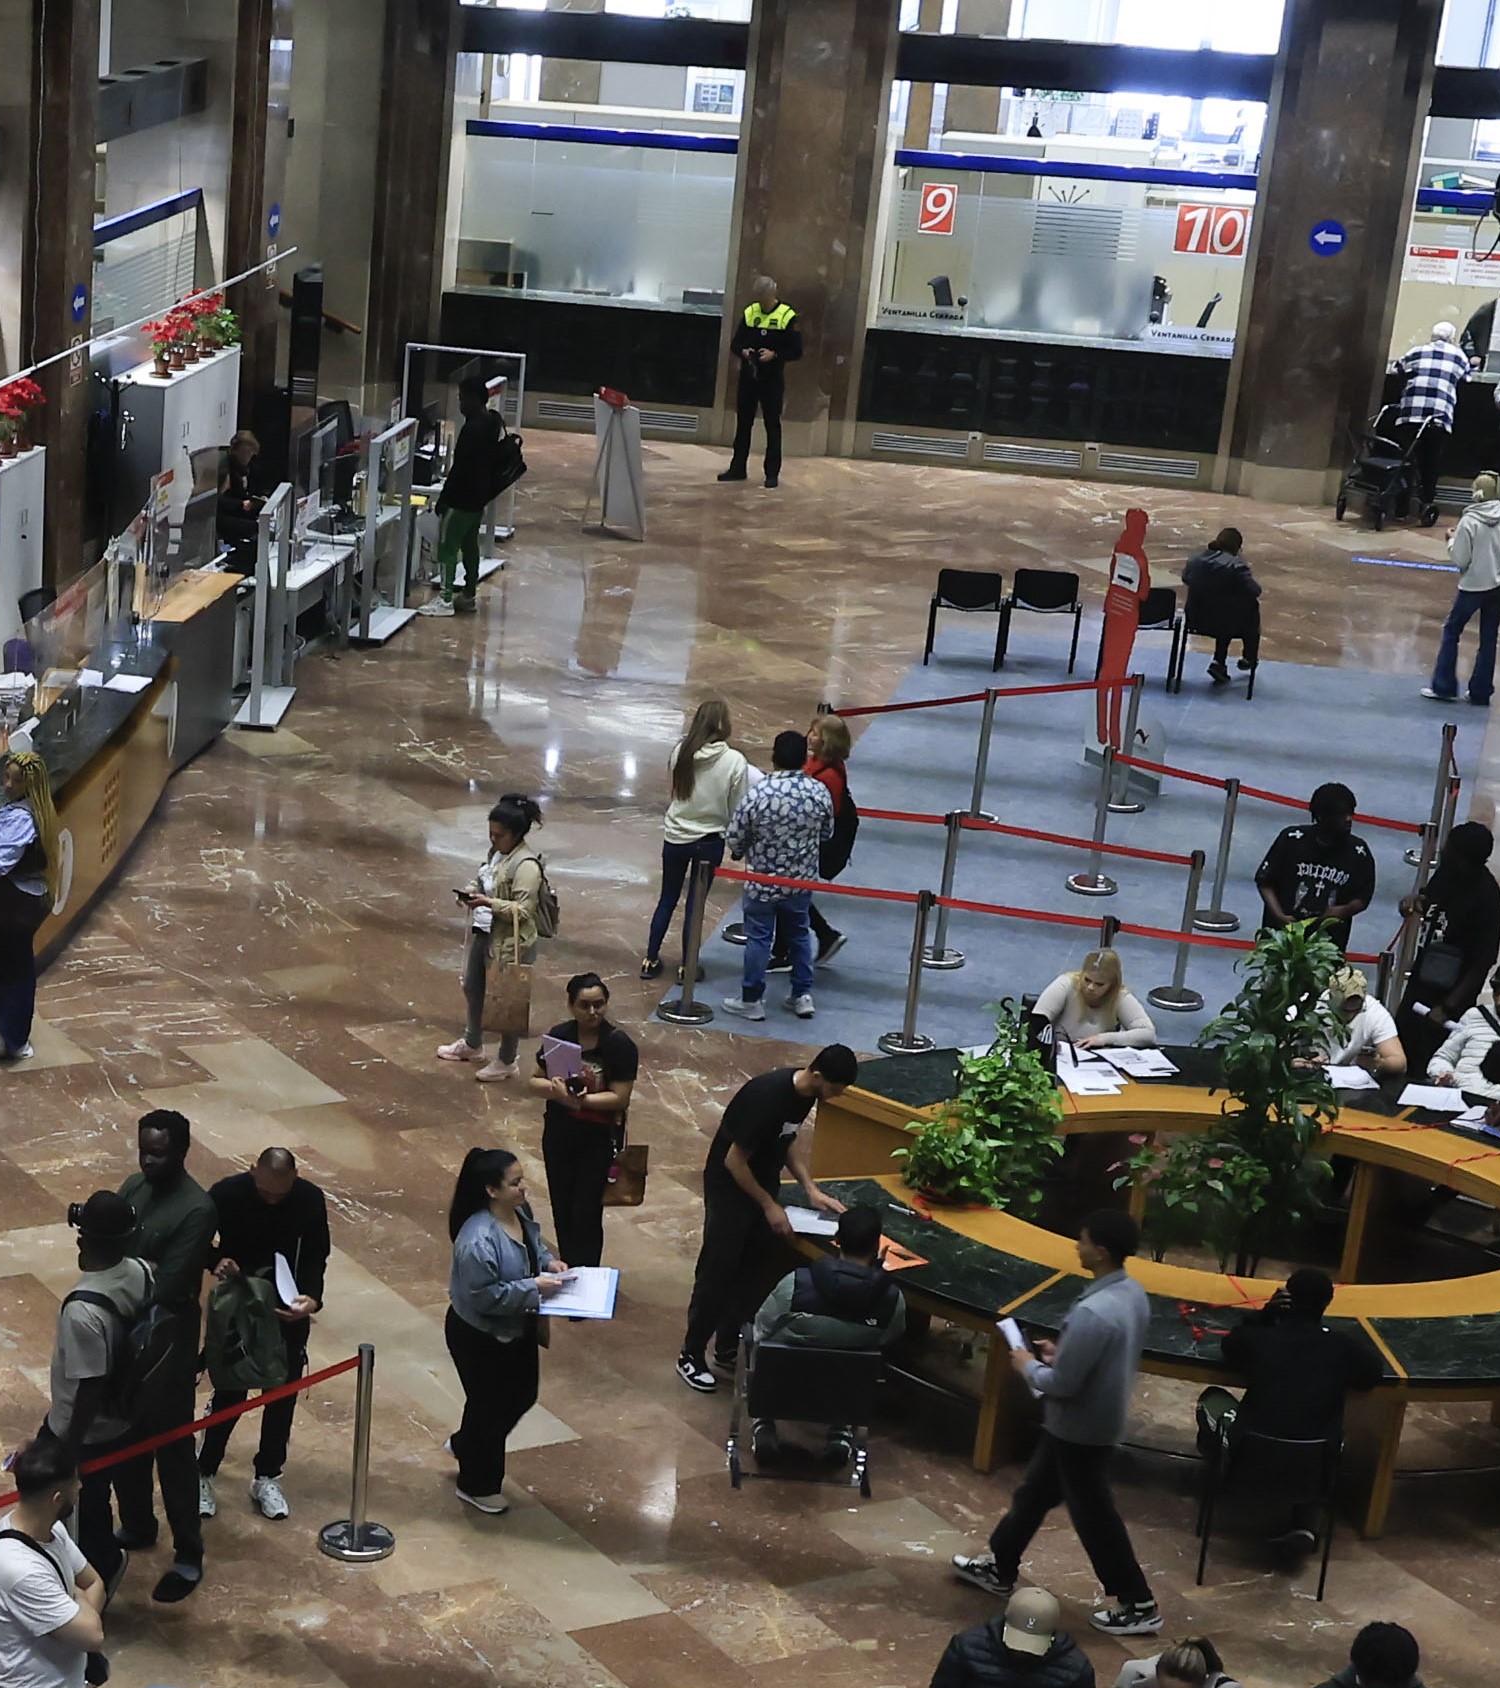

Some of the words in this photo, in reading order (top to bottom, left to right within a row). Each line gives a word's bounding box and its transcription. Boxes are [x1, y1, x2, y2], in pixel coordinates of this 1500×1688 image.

[920, 187, 953, 230] 9
[1184, 207, 1244, 253] 10
[1151, 329, 1198, 341] VENTANILLA
